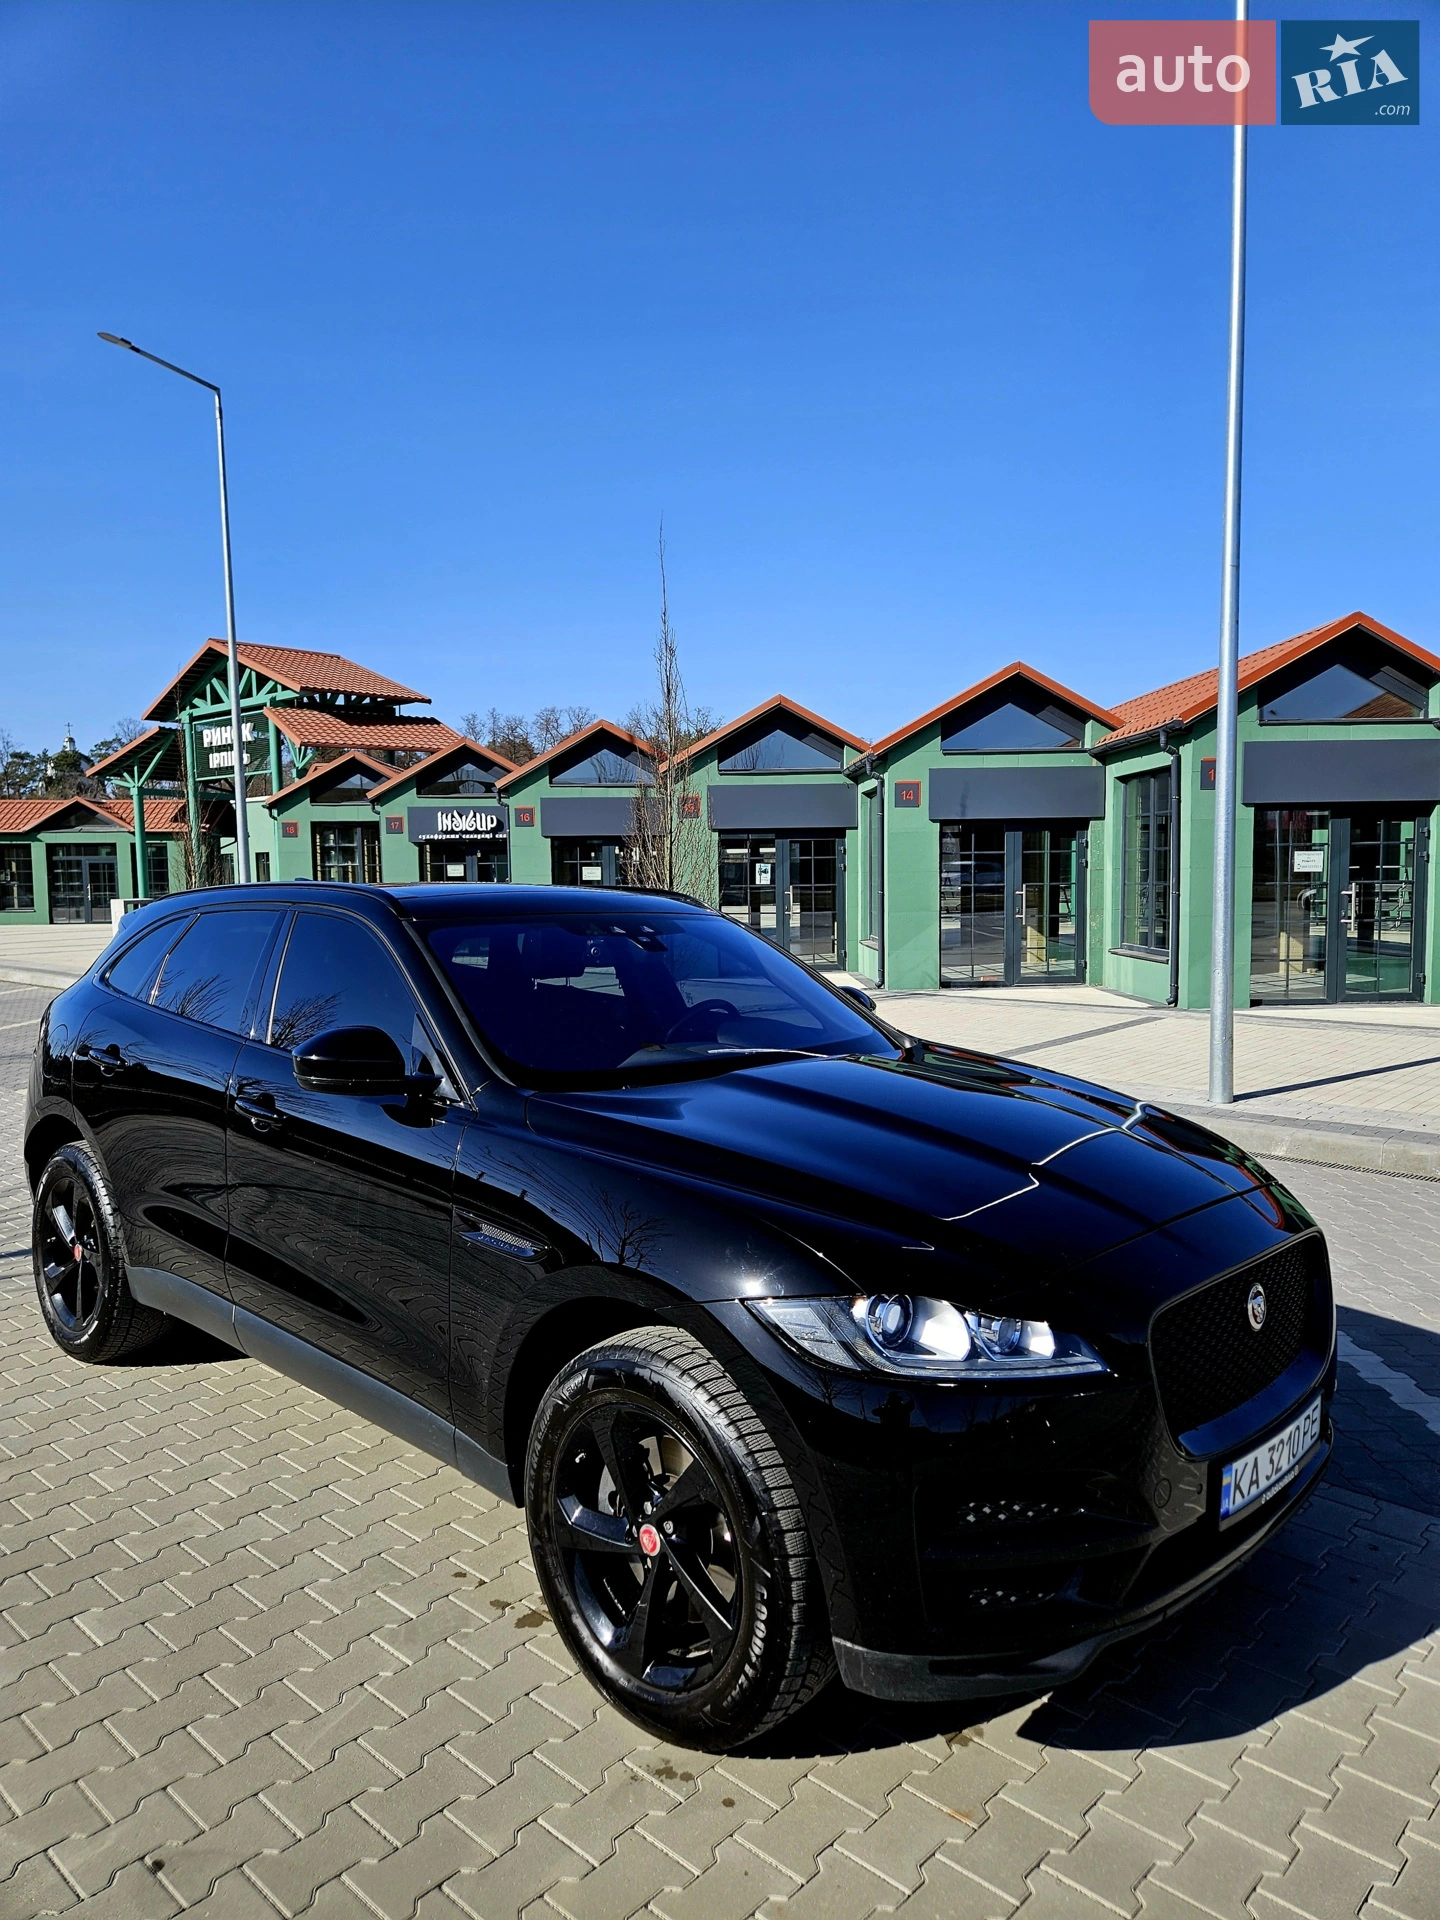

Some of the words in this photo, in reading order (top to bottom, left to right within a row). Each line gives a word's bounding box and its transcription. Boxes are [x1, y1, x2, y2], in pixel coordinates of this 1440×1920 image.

[203, 722, 255, 748] РИНК
[901, 790, 914, 801] 14
[519, 813, 530, 822] 16
[285, 826, 295, 834] 18
[390, 821, 400, 829] 17
[1232, 1456, 1260, 1506] KA
[1265, 1424, 1300, 1482] 3210
[1302, 1404, 1319, 1450] PE
